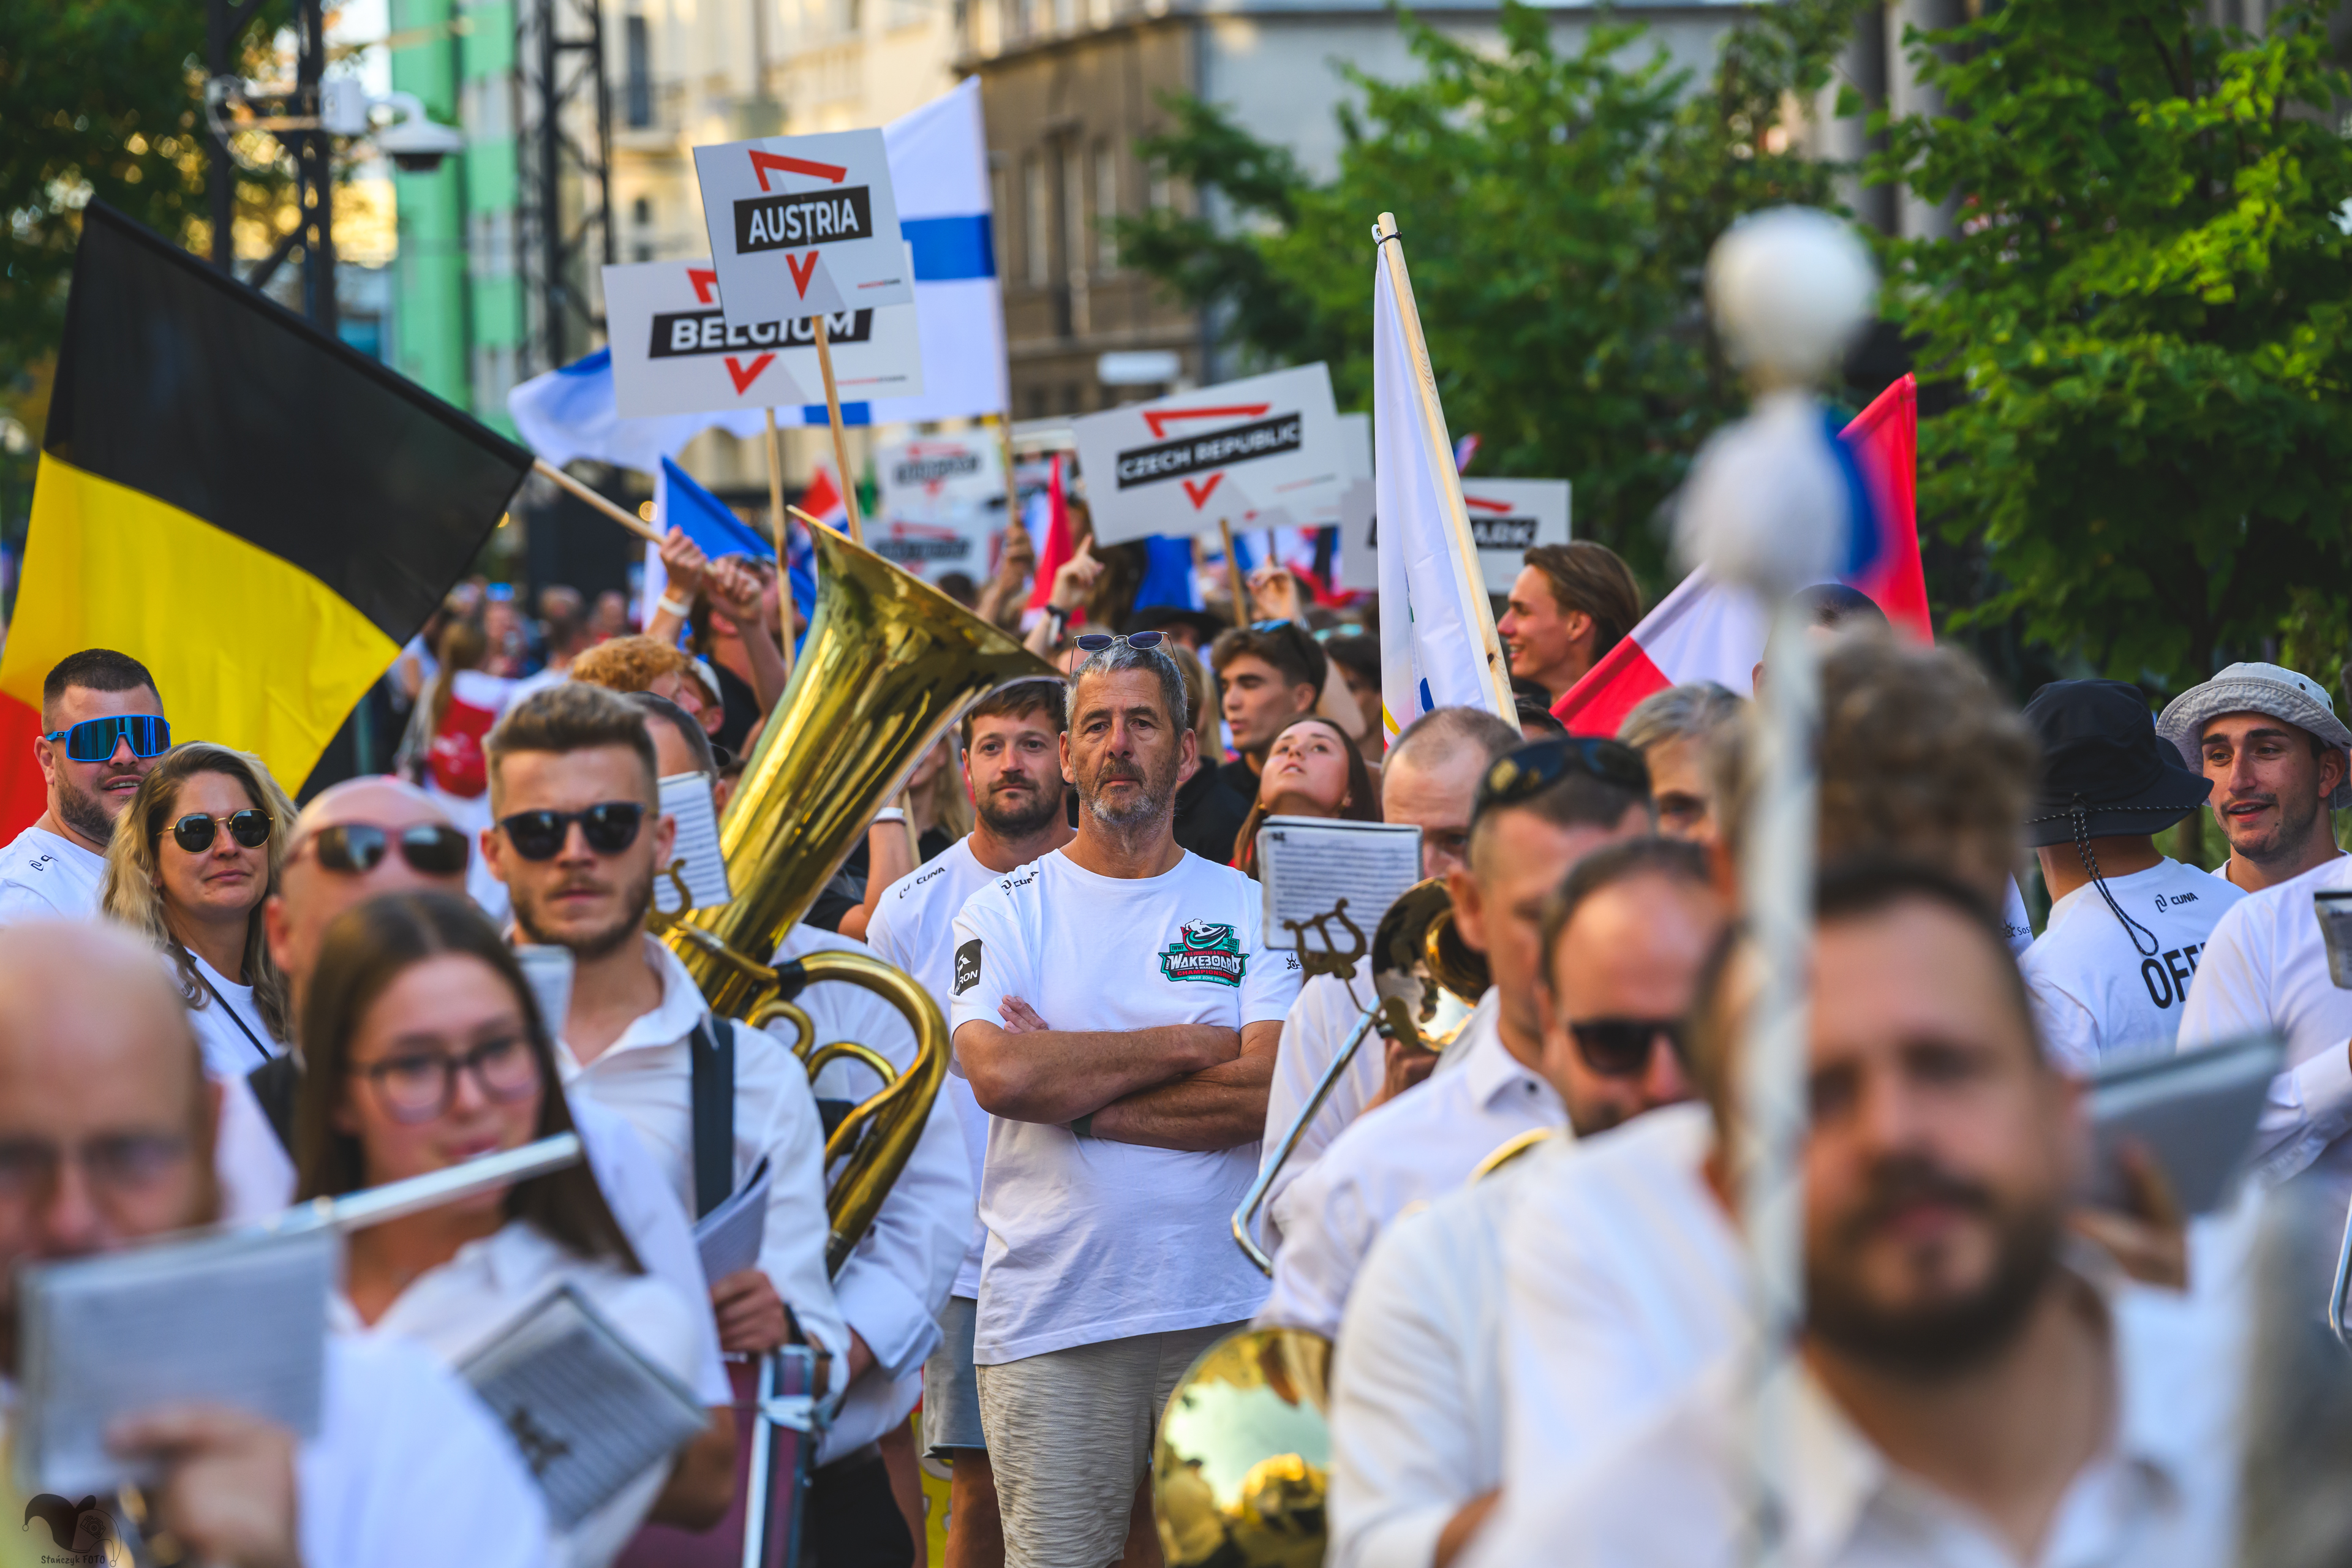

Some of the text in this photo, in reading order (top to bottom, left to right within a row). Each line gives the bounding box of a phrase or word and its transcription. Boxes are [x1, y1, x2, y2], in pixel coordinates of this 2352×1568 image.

[748, 198, 860, 245] AUSTRIA
[669, 309, 857, 351] BELGIUM
[1120, 421, 1300, 480] CZECH REPUBLIC
[917, 867, 946, 885] CUNA
[1013, 871, 1039, 888] CUNA
[2171, 892, 2199, 905] CUNA
[1167, 953, 1242, 974] WAKEBOARD
[1177, 970, 1234, 981] CHAMPIONSHIPS
[2141, 942, 2206, 1009] OFF
